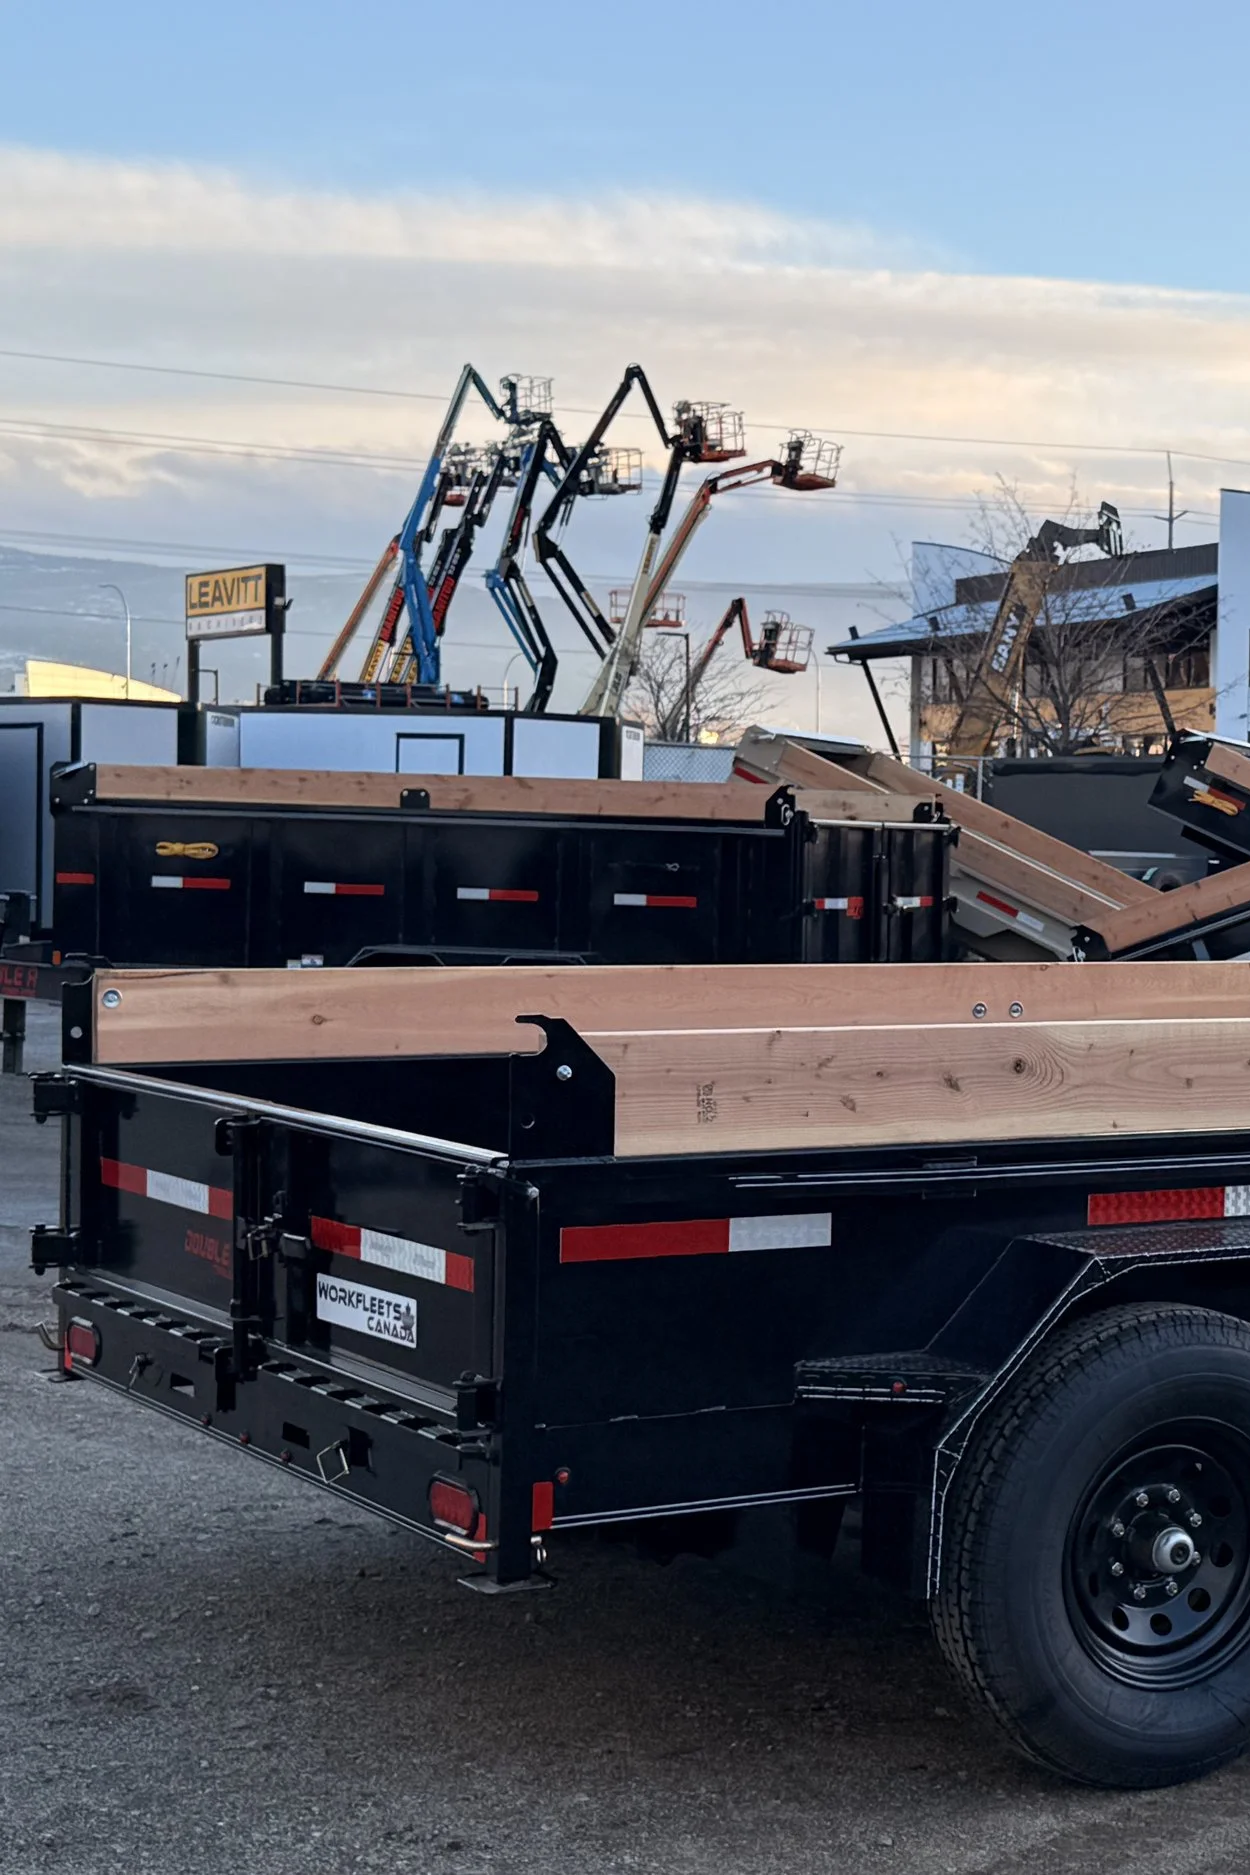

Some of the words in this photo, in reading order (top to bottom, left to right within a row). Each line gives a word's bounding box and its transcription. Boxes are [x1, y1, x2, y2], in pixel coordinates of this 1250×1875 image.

[189, 574, 263, 610] LEAVITT
[380, 587, 405, 642] MANITOU
[991, 611, 1020, 673] SANY
[184, 1229, 232, 1267] DOUBLE
[318, 1280, 402, 1322] WORKFLEETS
[366, 1315, 415, 1344] CANADA
